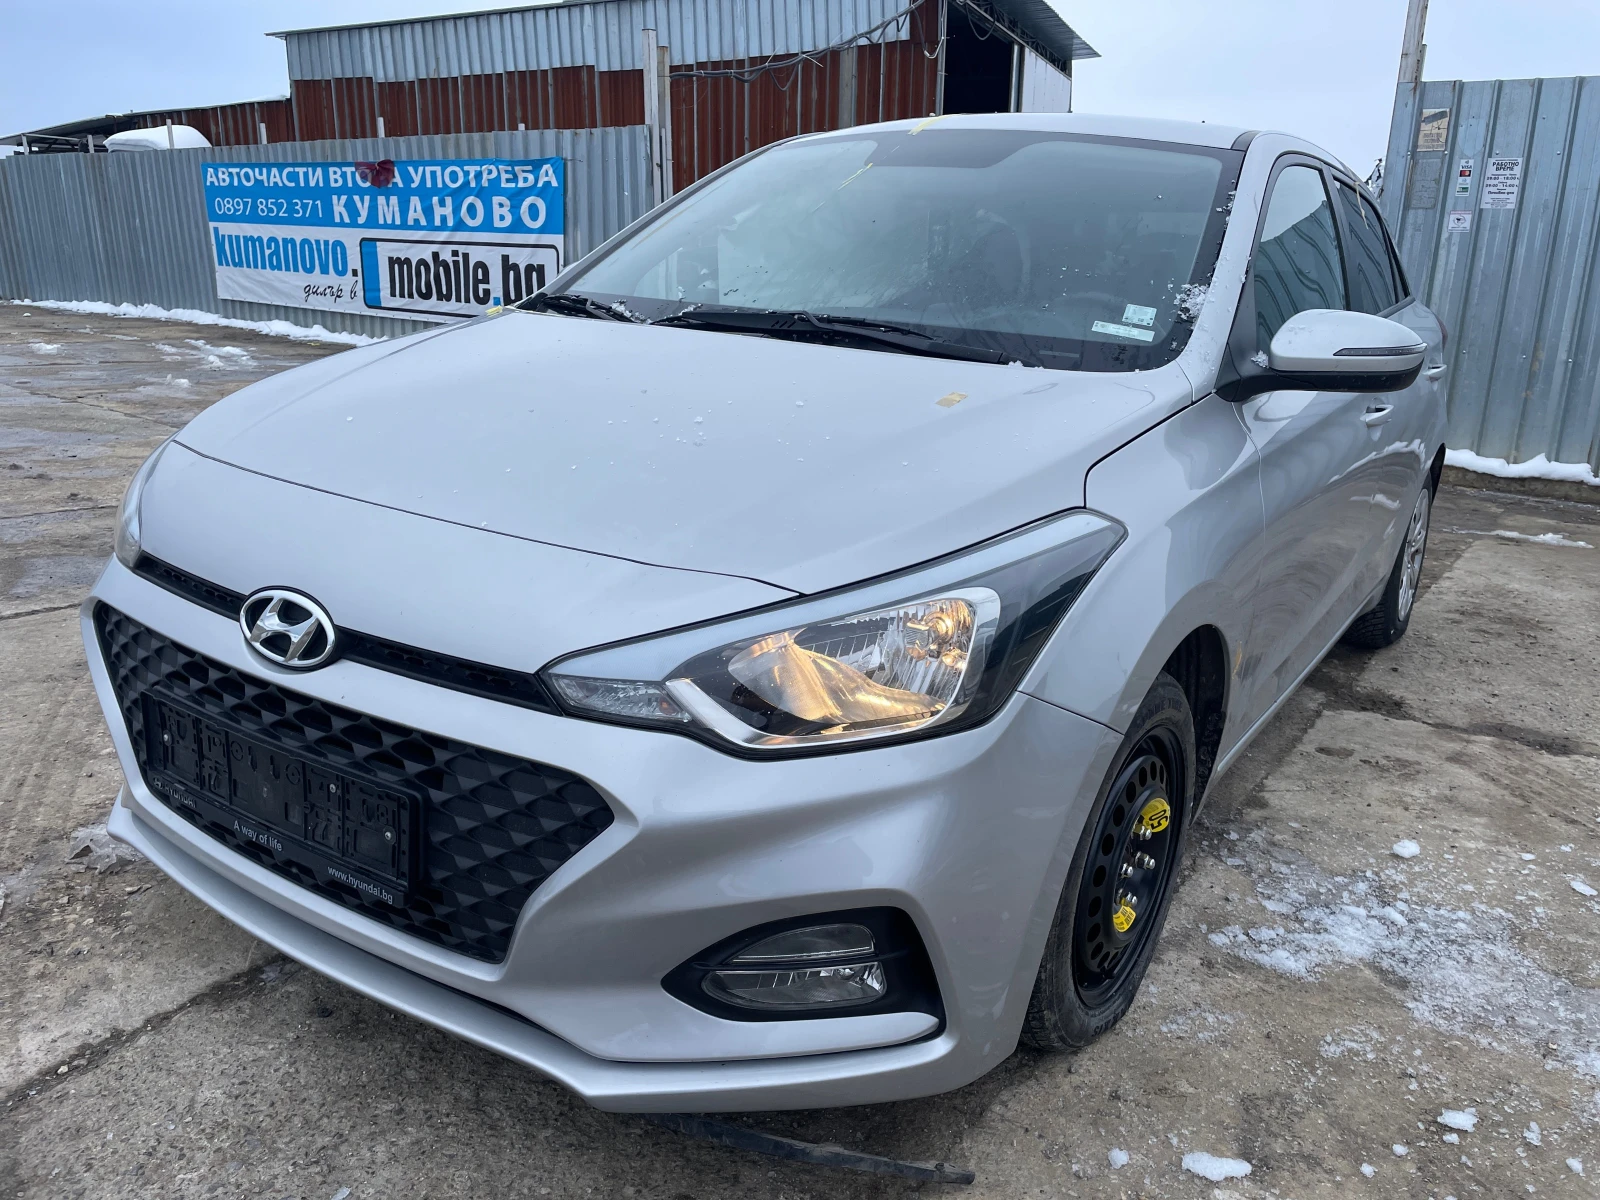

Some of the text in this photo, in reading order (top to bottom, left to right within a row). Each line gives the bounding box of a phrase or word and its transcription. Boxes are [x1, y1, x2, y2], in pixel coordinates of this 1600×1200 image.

[206, 164, 559, 188] АВТОЧАСТИ ВТОА УПОТРЕБА
[214, 195, 547, 229] 0897 852 371 КУМАНОВО
[303, 283, 344, 303] дилър
[1148, 809, 1169, 830] 50
[233, 820, 282, 852] A way of life
[327, 866, 393, 905] www.hyundai.bg
